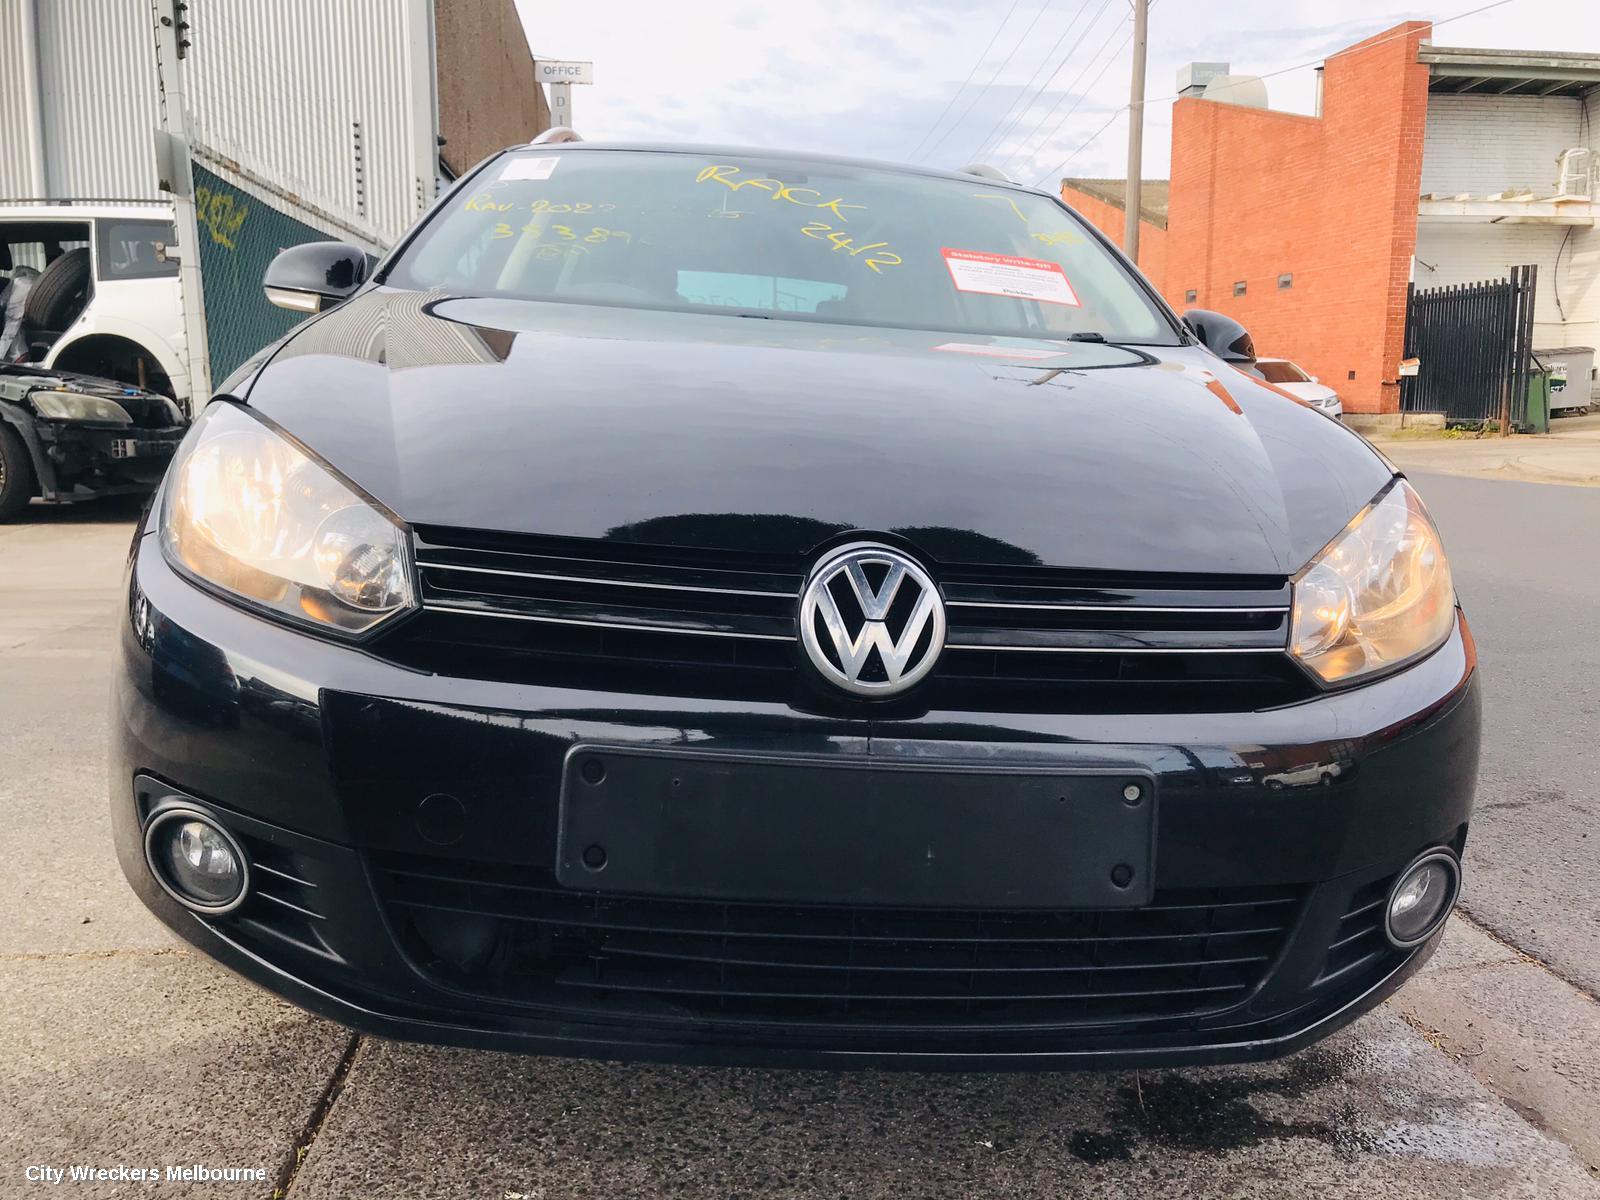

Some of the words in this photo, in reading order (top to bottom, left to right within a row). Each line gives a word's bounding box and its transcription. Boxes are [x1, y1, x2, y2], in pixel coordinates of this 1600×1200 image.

[543, 66, 581, 75] OFFICE
[696, 165, 868, 223] RACK
[803, 551, 944, 693] VW
